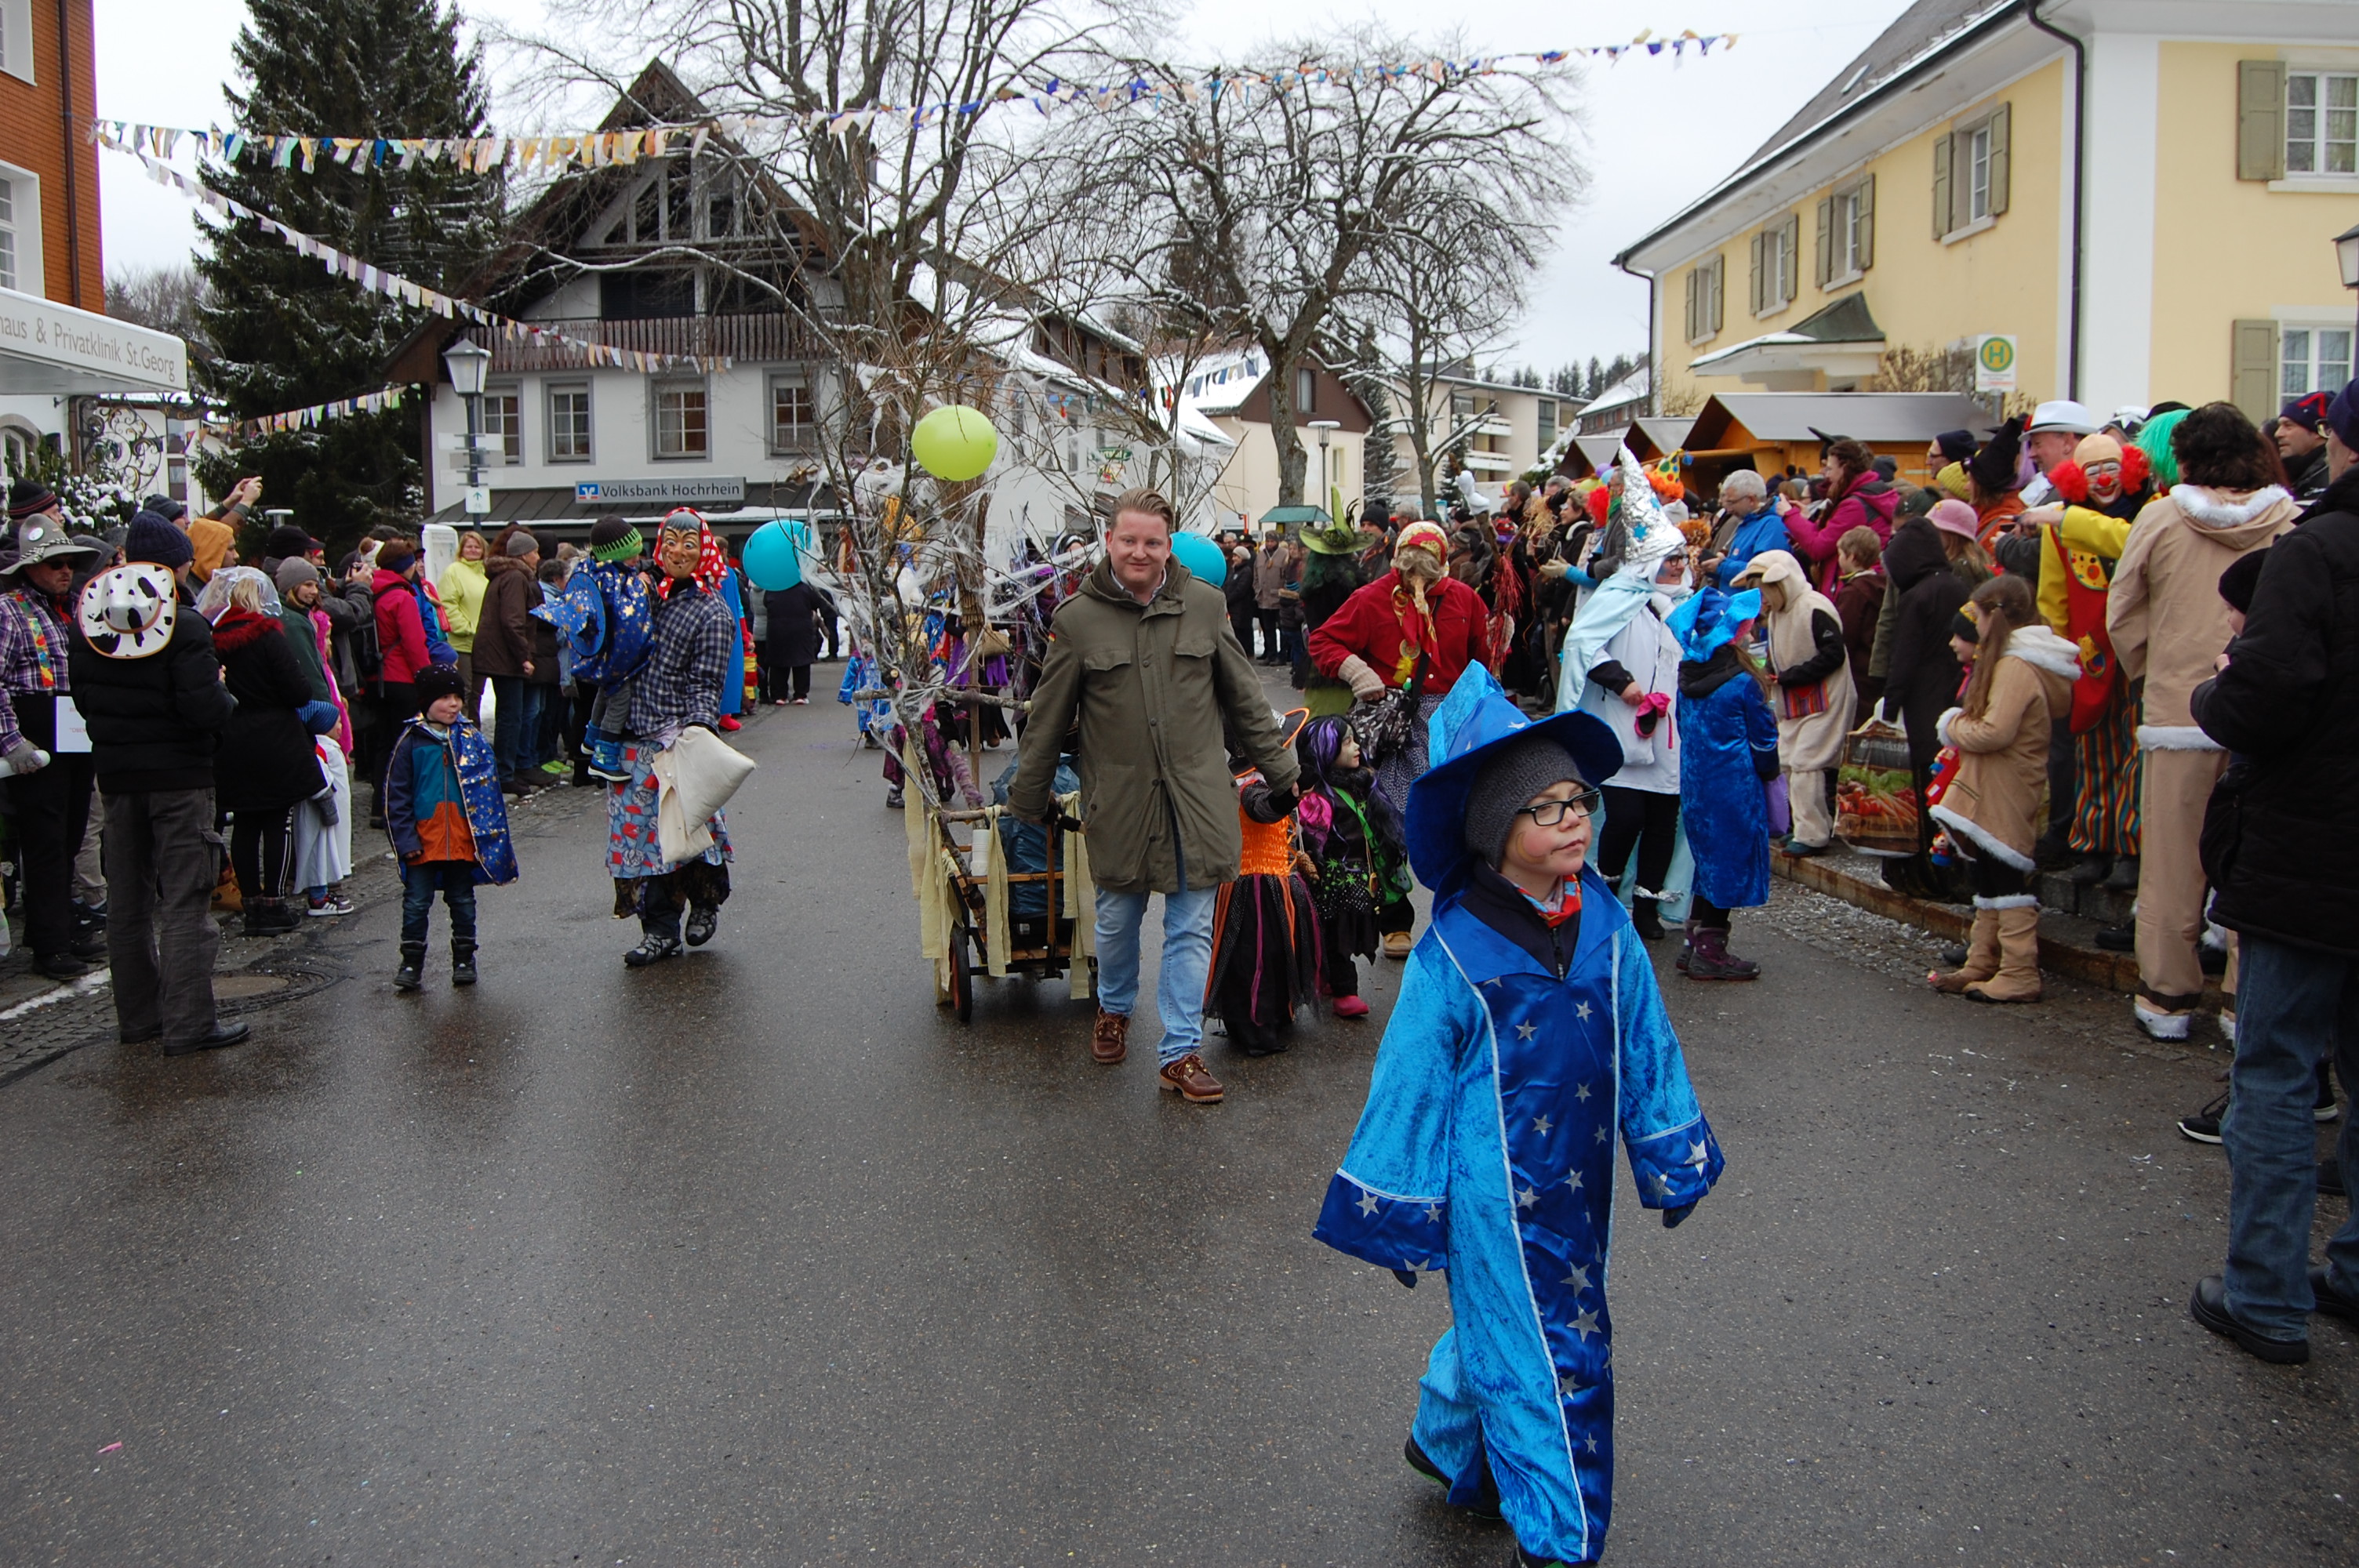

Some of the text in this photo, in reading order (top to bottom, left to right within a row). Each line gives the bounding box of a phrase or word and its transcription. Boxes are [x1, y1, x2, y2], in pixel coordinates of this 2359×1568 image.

[36, 317, 47, 344] &
[54, 321, 122, 363] Privatklinik
[1989, 345, 2005, 364] H
[602, 483, 740, 498] Volksbank Hochrhein
